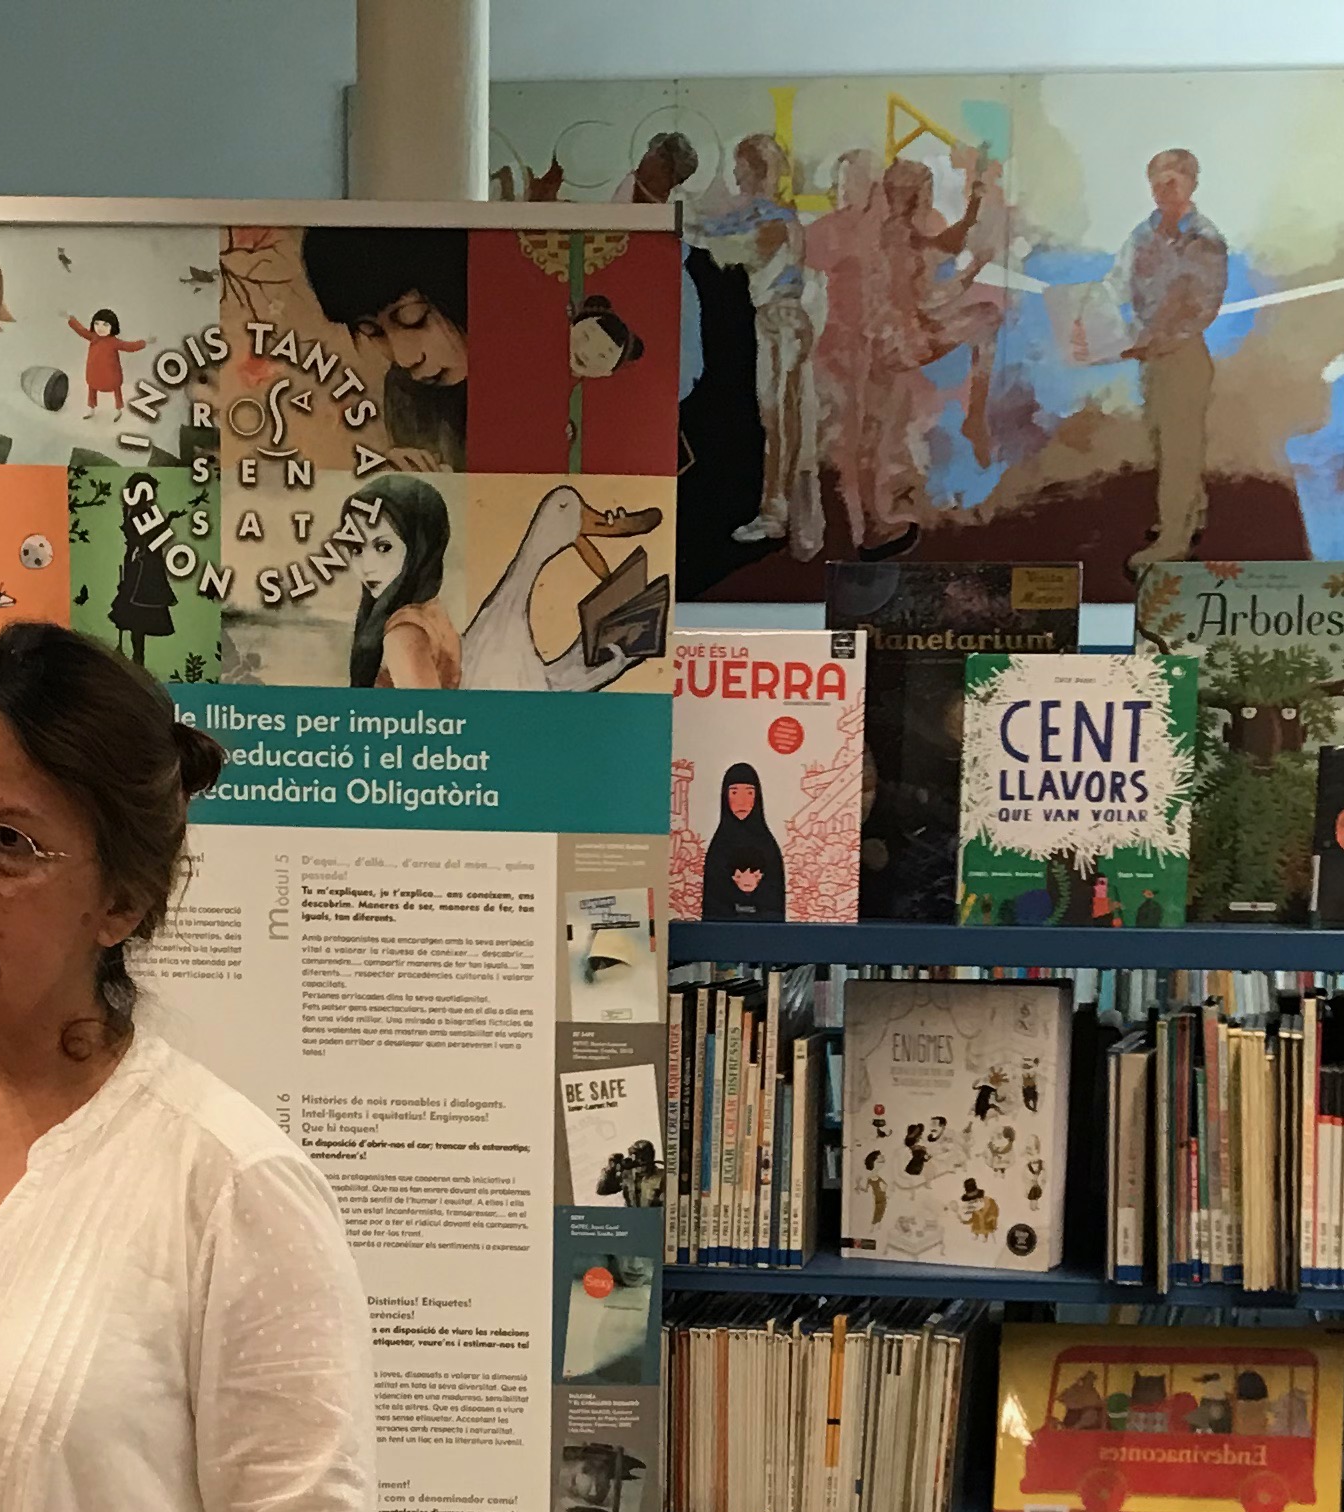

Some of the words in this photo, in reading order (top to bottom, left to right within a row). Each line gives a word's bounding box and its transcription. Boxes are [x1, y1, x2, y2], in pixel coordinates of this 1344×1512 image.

[129, 327, 228, 419] NOIS
[247, 322, 377, 426] TANTS
[356, 444, 387, 476] A
[123, 481, 233, 599] NOIES
[260, 497, 383, 603] TANTS
[676, 643, 706, 659] QUÈ
[709, 643, 727, 659] ÉS
[731, 646, 749, 659] LA
[858, 623, 1055, 652] Planetarium
[207, 704, 285, 730] llibres
[297, 714, 340, 737] per
[350, 709, 466, 738] impulsar
[999, 700, 1153, 765] CENT
[224, 741, 353, 767] educació
[364, 744, 369, 768] i
[380, 744, 402, 769] el
[413, 745, 490, 770] debat
[347, 778, 498, 810] Obligatòria
[999, 769, 1150, 804] LLAVORS
[998, 807, 1035, 825] QUE
[1043, 806, 1082, 825] VAN
[1090, 806, 1150, 825] VOLAR
[892, 1032, 954, 1065] ENIGMES
[565, 1082, 585, 1103] BE
[589, 1079, 627, 1101] SAFE
